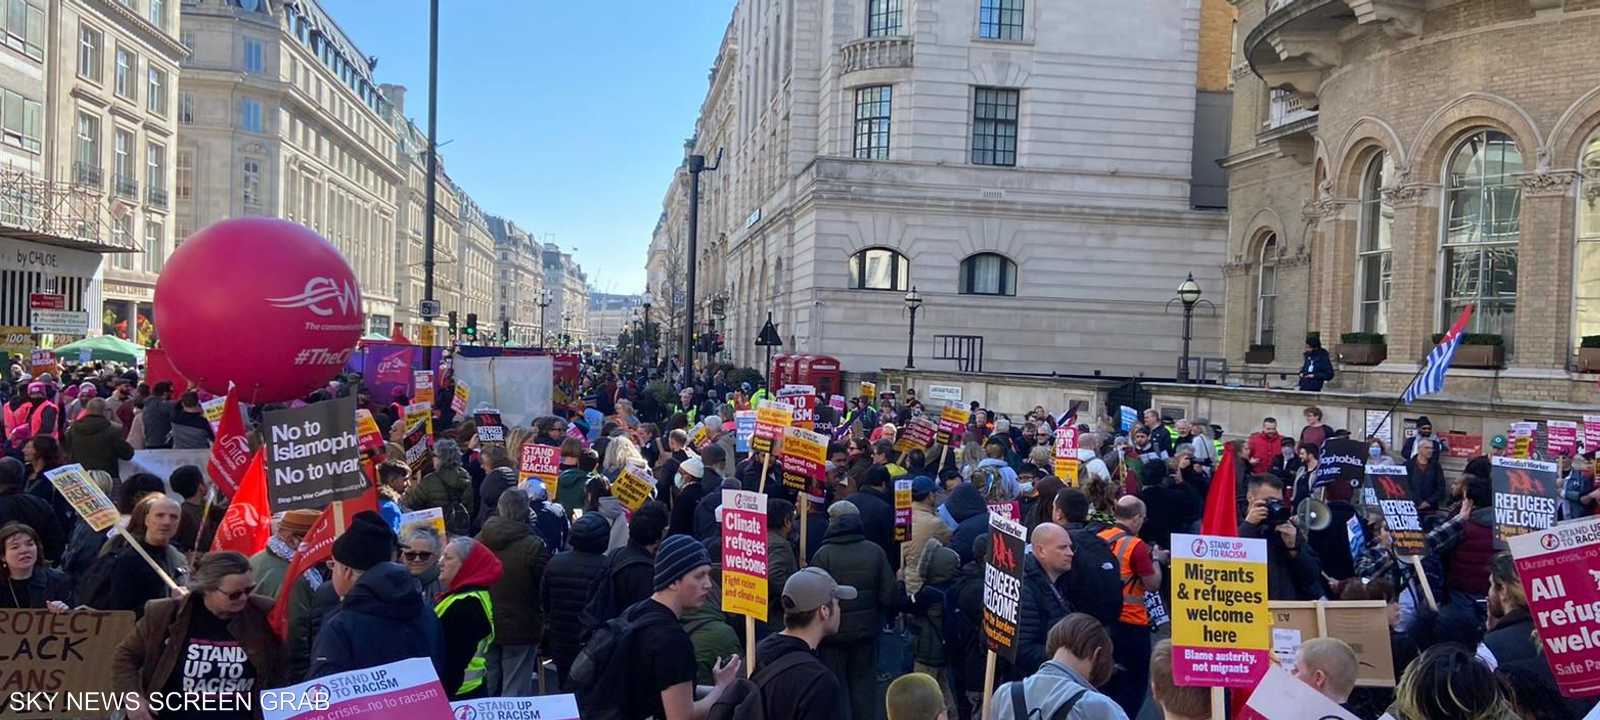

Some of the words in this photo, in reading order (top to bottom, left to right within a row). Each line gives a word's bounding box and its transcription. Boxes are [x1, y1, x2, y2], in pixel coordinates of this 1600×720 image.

[16, 249, 27, 267] by
[793, 395, 806, 408] TO
[794, 408, 813, 421] ISM
[272, 423, 301, 444] No
[305, 420, 320, 437] to
[1056, 428, 1074, 439] STAND
[273, 431, 358, 461] Islamoph
[523, 446, 554, 457] STAND
[521, 463, 558, 474] RACISM
[522, 454, 537, 464] UP
[539, 455, 551, 465] TO
[274, 465, 305, 486] No
[307, 462, 324, 481] to
[1379, 499, 1418, 515] REFUGEES
[1495, 492, 1555, 514] REFUGEES
[725, 512, 761, 534] Climate
[1384, 514, 1423, 531] WELCOME
[1494, 507, 1554, 529] WELCOME
[1558, 525, 1589, 538] STAND
[725, 532, 766, 557] refugees
[1209, 540, 1231, 550] STAND
[1231, 543, 1243, 551] UP
[1560, 537, 1574, 548] TO
[1209, 549, 1219, 558] TO
[1219, 550, 1248, 559] RACISM
[725, 552, 767, 576] welcome
[985, 562, 1021, 602] REFUGEES
[1184, 562, 1255, 585] Migrants
[1177, 582, 1189, 601] &
[1193, 585, 1263, 607] refugees
[1531, 574, 1566, 602] All
[983, 582, 1019, 625] WELCOME
[1186, 604, 1254, 624] welcome
[1203, 625, 1238, 643] here
[187, 644, 248, 663] STAND
[1184, 649, 1214, 661] Blame
[1215, 652, 1257, 664] austerity,
[184, 660, 212, 679] UP
[217, 662, 244, 679] TO
[1192, 662, 1209, 672] not
[1210, 663, 1250, 675] migrants
[1555, 662, 1584, 676] Safe
[182, 677, 255, 695] RACISM
[329, 673, 368, 690] STAND
[370, 669, 388, 681] UP
[332, 687, 351, 699] TO
[353, 677, 400, 695] RACISM
[384, 697, 398, 708] to
[399, 687, 438, 705] racism
[478, 702, 515, 712] STAND
[516, 700, 533, 710] UP
[479, 712, 496, 720] TO
[497, 710, 541, 720] RACISM
